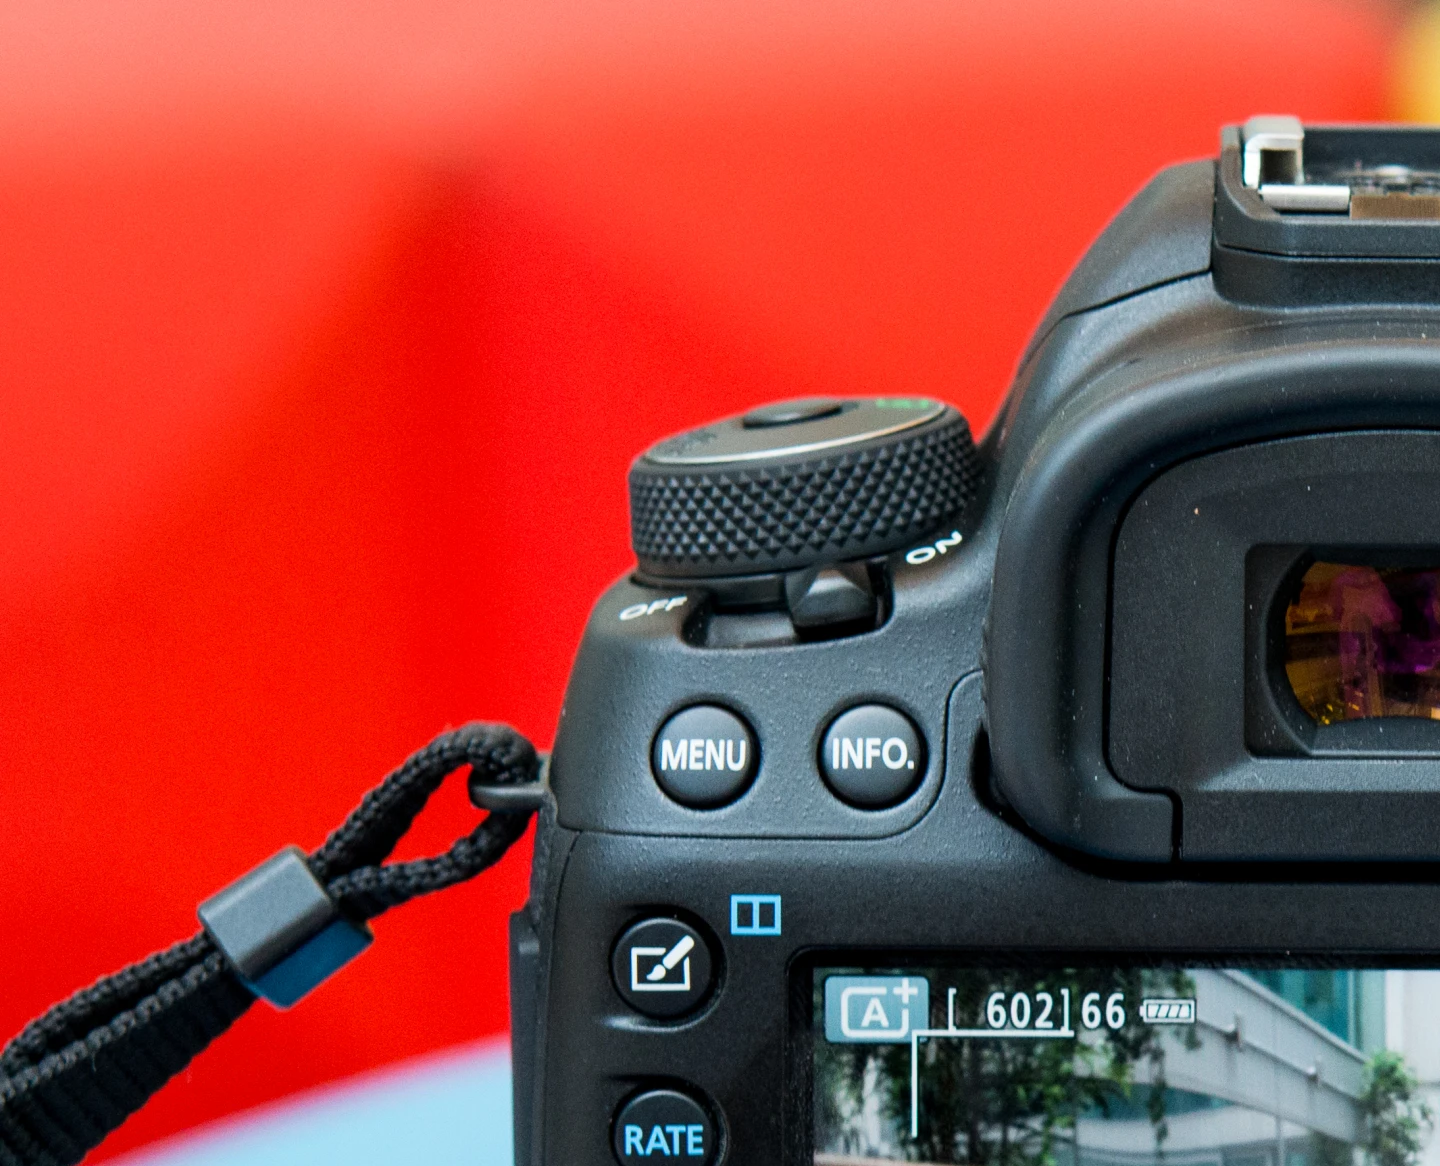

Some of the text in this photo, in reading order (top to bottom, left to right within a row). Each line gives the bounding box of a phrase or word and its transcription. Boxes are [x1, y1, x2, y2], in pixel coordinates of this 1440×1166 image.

[906, 531, 962, 565] ON
[619, 596, 688, 621] OFF
[660, 738, 746, 772] MENU
[831, 737, 915, 770] INFO.
[1081, 992, 1126, 1030] 66
[624, 1124, 704, 1156] RATE
